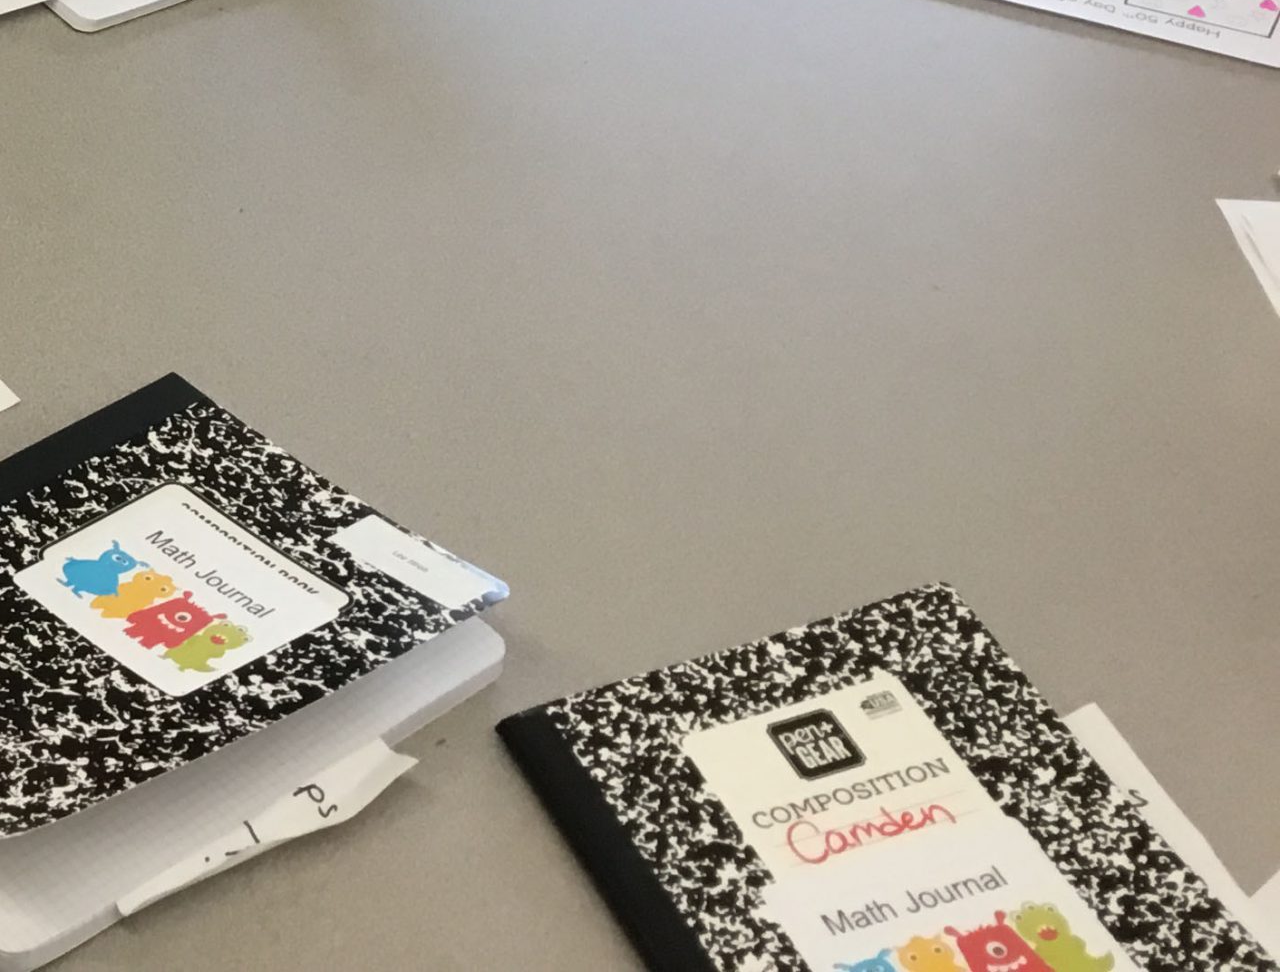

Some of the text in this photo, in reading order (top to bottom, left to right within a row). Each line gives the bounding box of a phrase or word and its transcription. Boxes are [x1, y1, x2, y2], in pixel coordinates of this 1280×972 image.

[1165, 17, 1222, 38] Happy
[145, 529, 197, 570] Math
[194, 569, 277, 619] Journal
[795, 736, 852, 769] GEAR
[751, 757, 952, 829] COMPOSITION
[786, 803, 957, 865] Camden
[820, 864, 1009, 937] Math Journal
